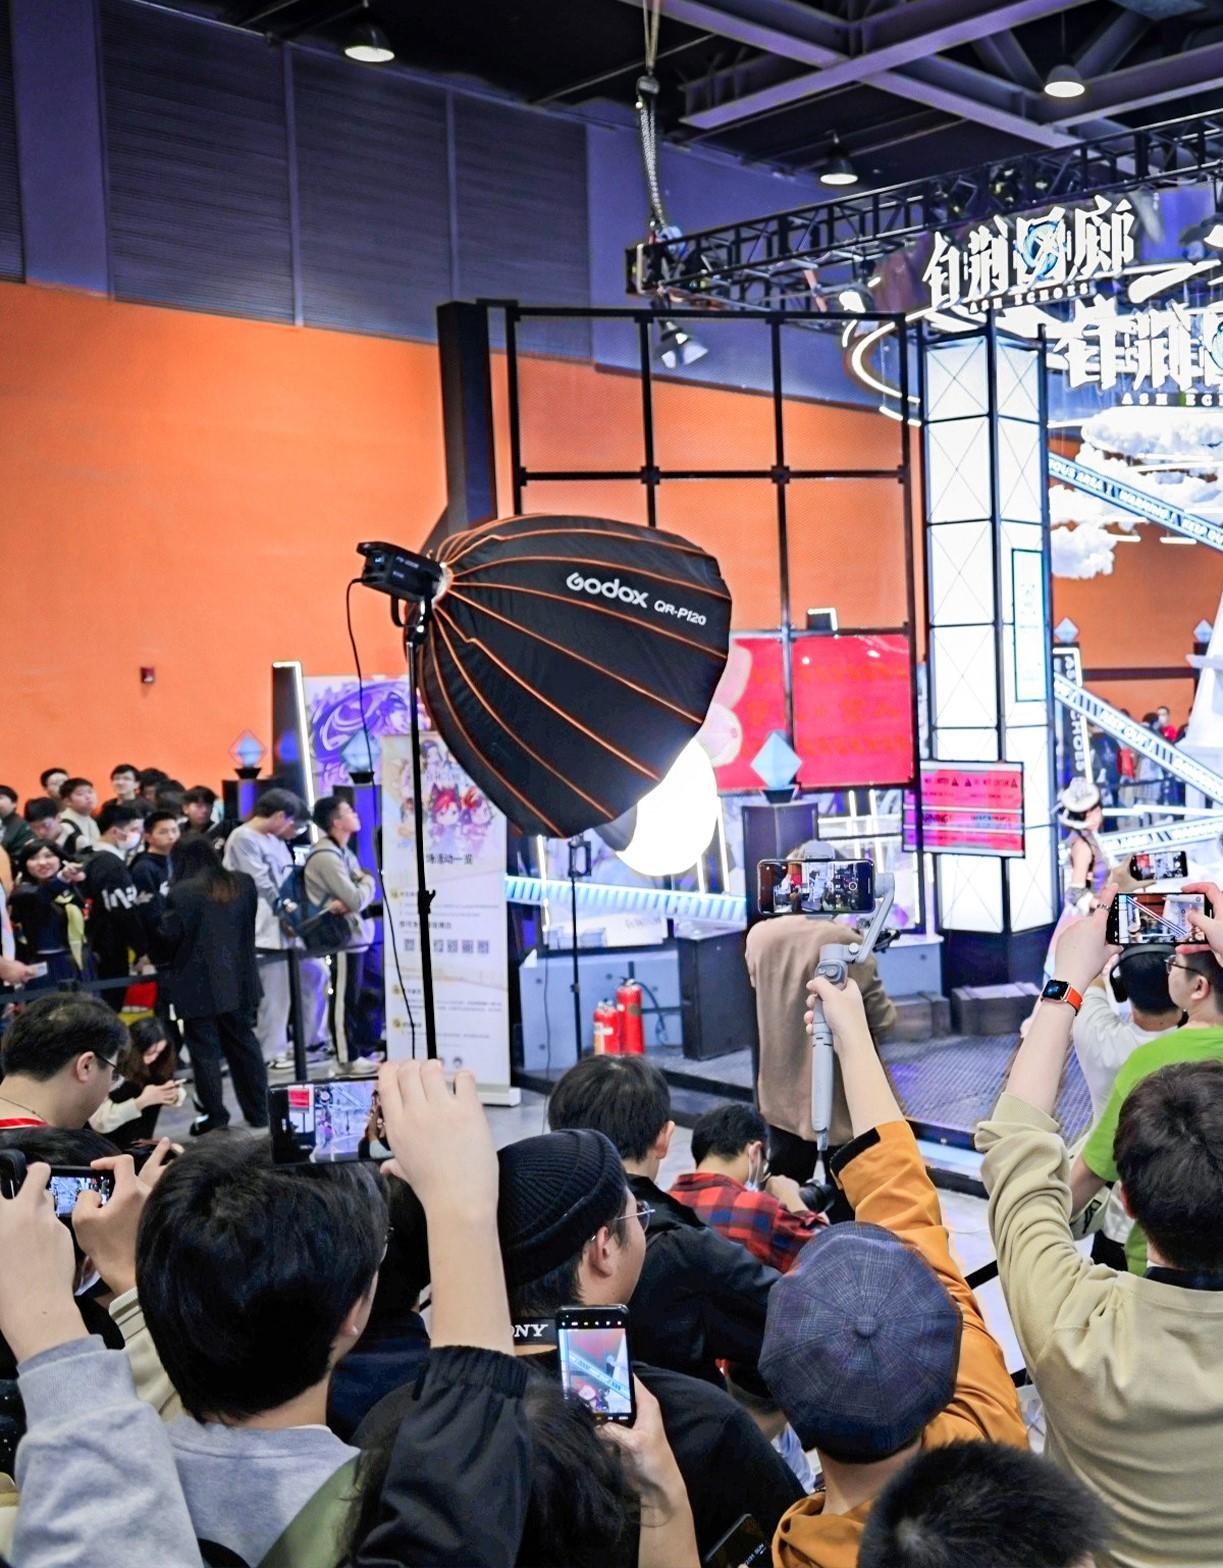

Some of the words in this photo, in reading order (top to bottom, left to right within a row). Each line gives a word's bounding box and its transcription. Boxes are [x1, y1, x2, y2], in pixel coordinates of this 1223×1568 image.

[1121, 392, 1168, 406] ASH
[653, 600, 707, 626] QR-P120
[511, 1323, 549, 1338] NY
